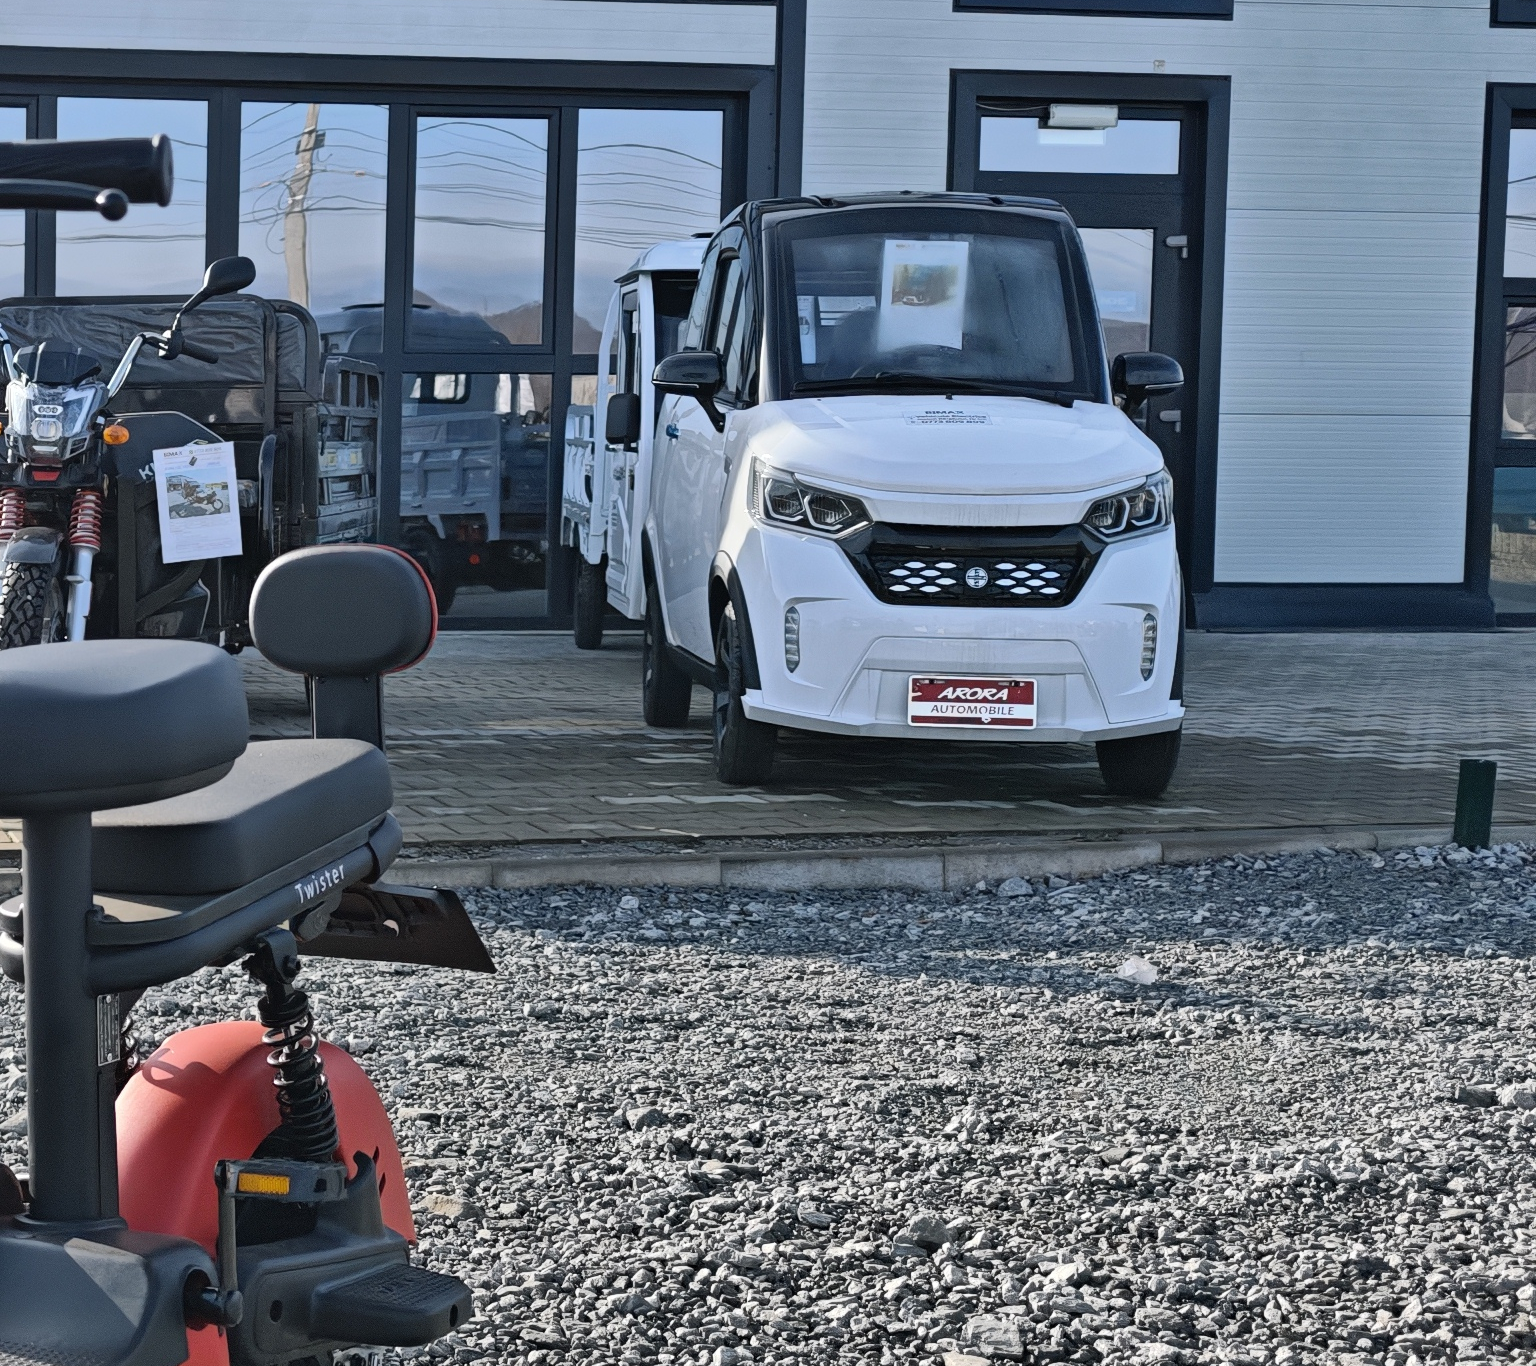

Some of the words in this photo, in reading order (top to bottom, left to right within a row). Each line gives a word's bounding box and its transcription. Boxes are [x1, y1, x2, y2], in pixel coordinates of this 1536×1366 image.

[937, 687, 1009, 700] ARORA
[931, 704, 1015, 716] AUTOMOBILE
[294, 864, 344, 904] Twister
